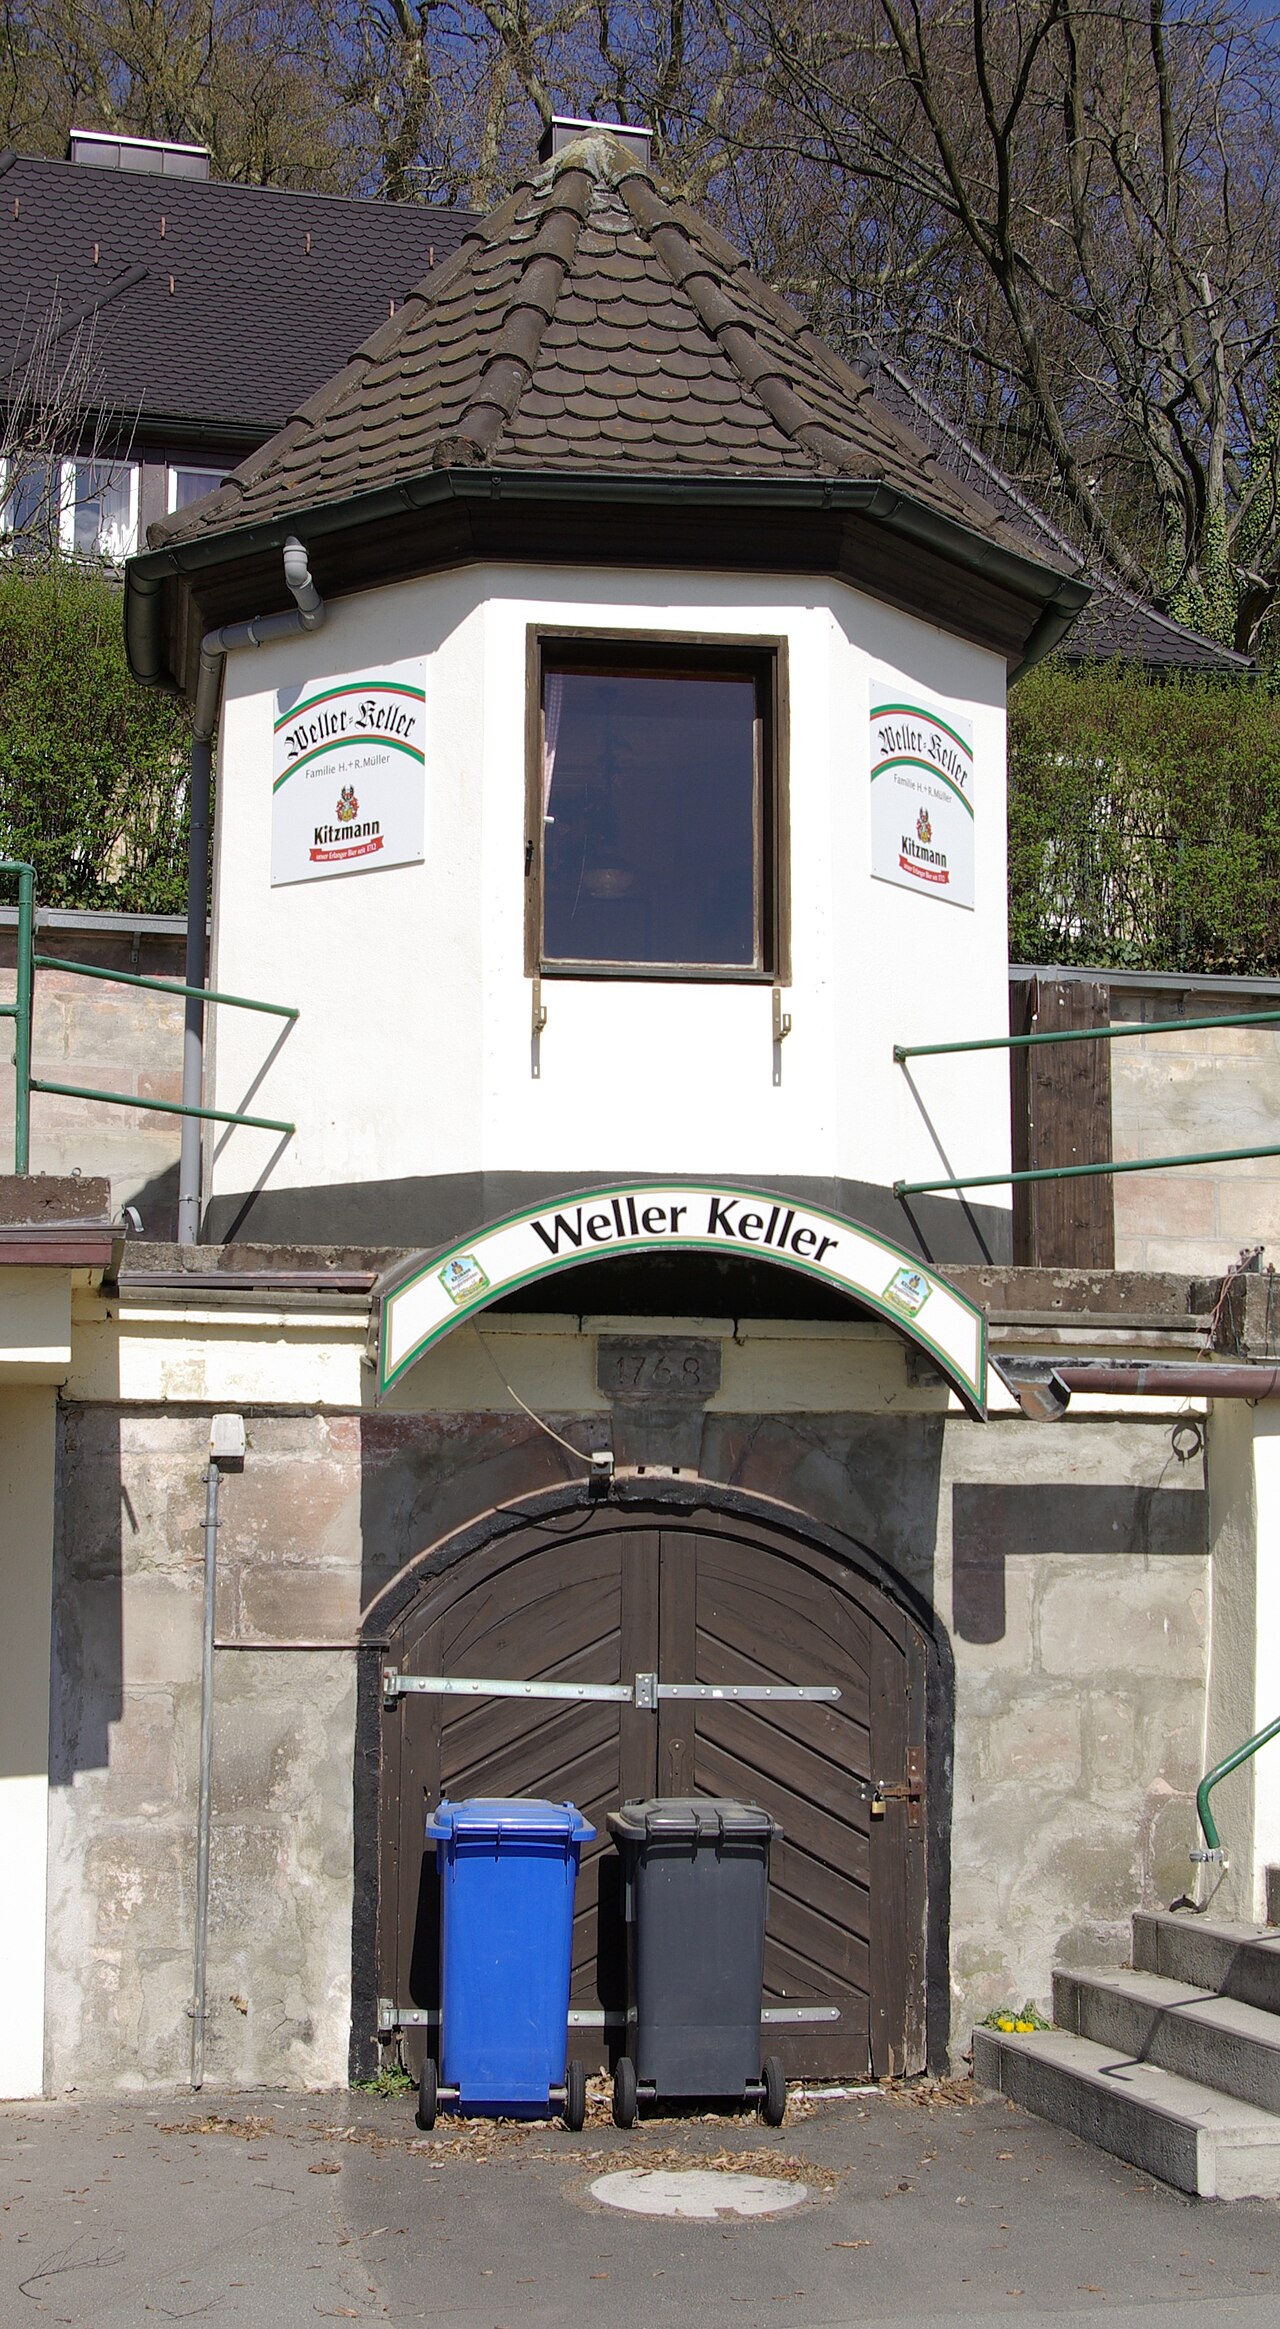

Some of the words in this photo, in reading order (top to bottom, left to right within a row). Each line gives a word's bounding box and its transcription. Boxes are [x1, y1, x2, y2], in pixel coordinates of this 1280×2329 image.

[305, 764, 336, 779] Familie
[893, 773, 916, 790] Familie
[314, 820, 380, 845] Kitzmann
[901, 835, 947, 868] Kitzmann
[530, 1197, 687, 1255] Weller
[707, 1197, 839, 1262] Keller
[617, 1356, 700, 1385] 1768
